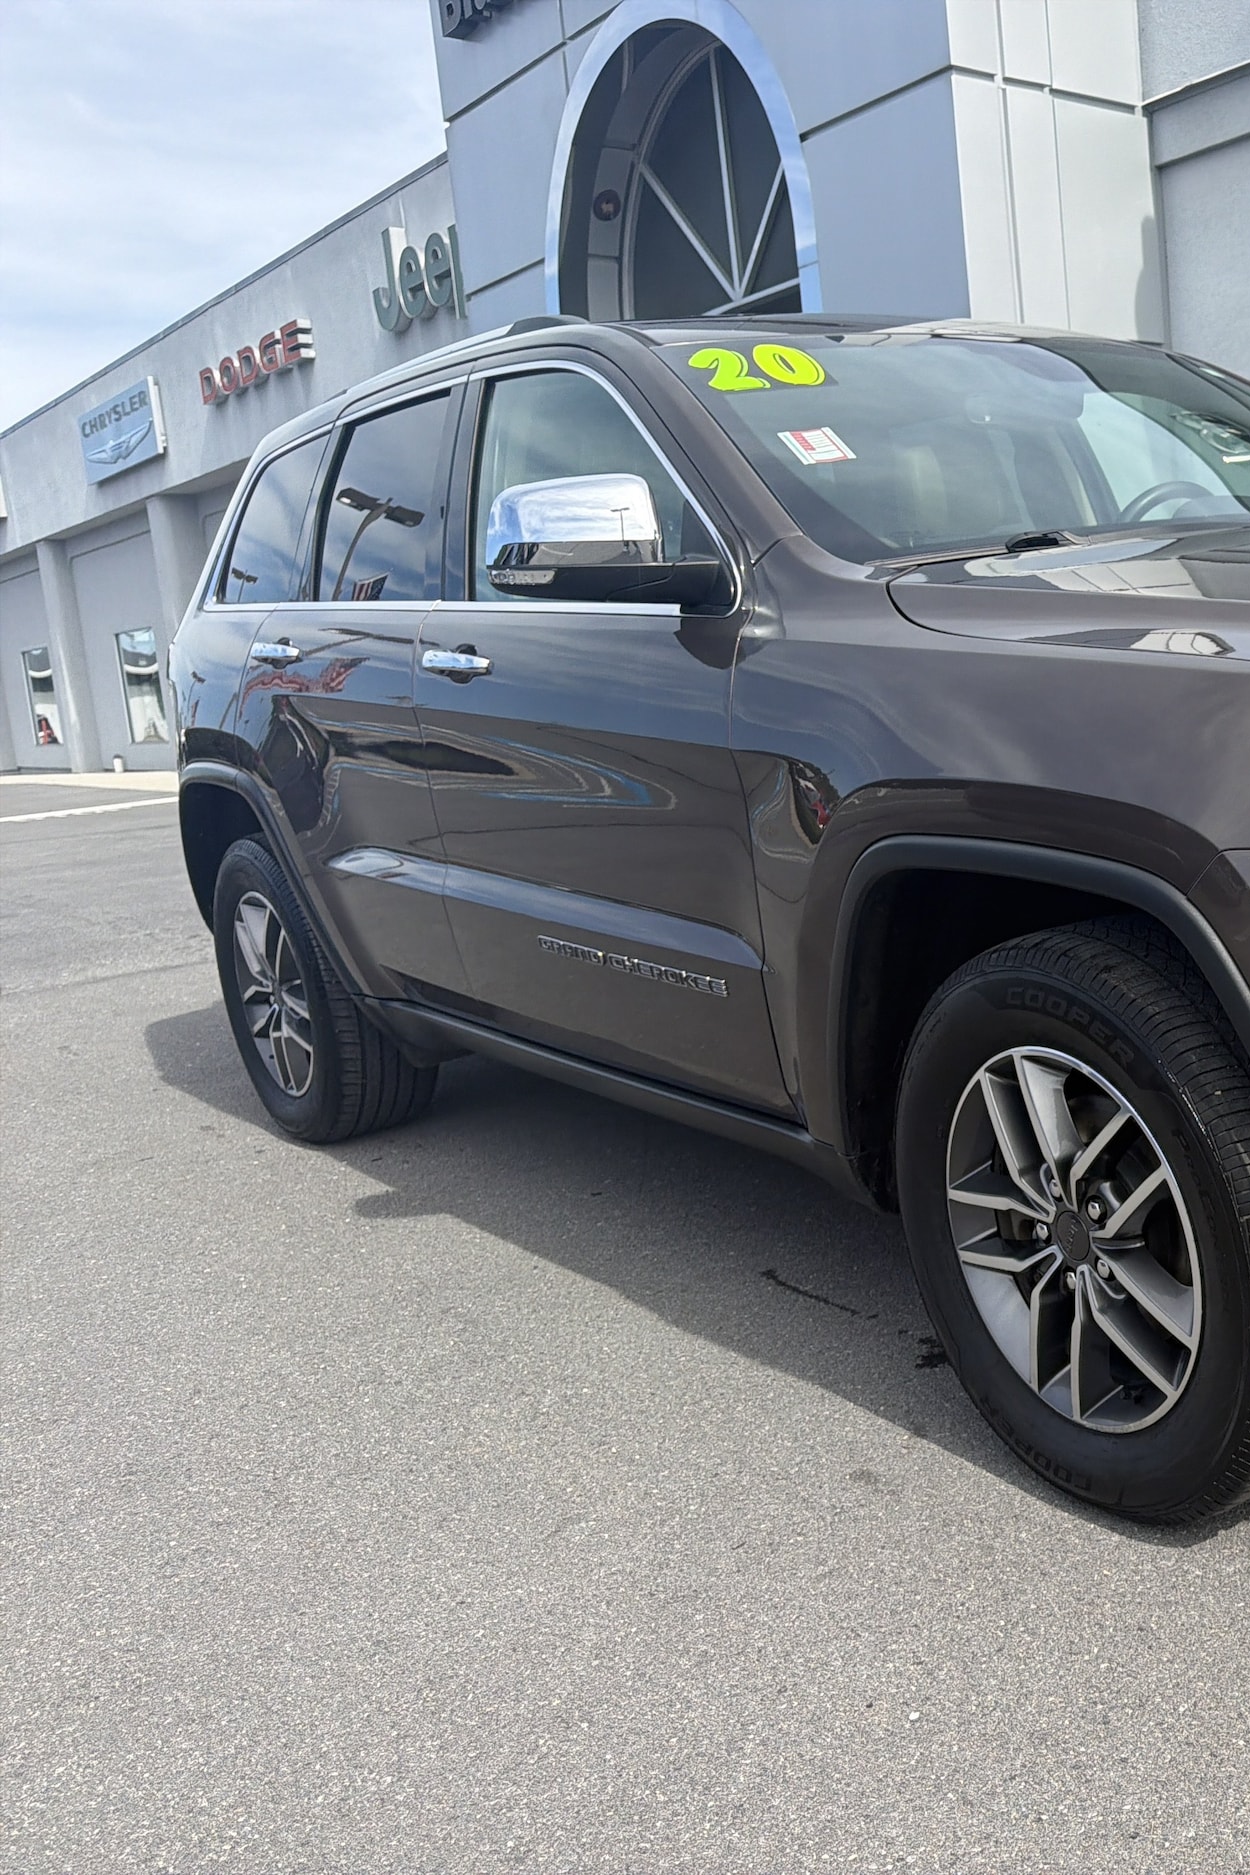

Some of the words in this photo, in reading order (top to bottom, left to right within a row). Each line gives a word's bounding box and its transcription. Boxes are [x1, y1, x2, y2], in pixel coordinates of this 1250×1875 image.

[198, 318, 305, 405] DODGE
[688, 343, 826, 391] 20
[81, 390, 149, 438] CHRYSLER
[537, 934, 607, 967] GRAND
[606, 952, 730, 998] CHEROKEE
[1006, 986, 1136, 1070] COOPER
